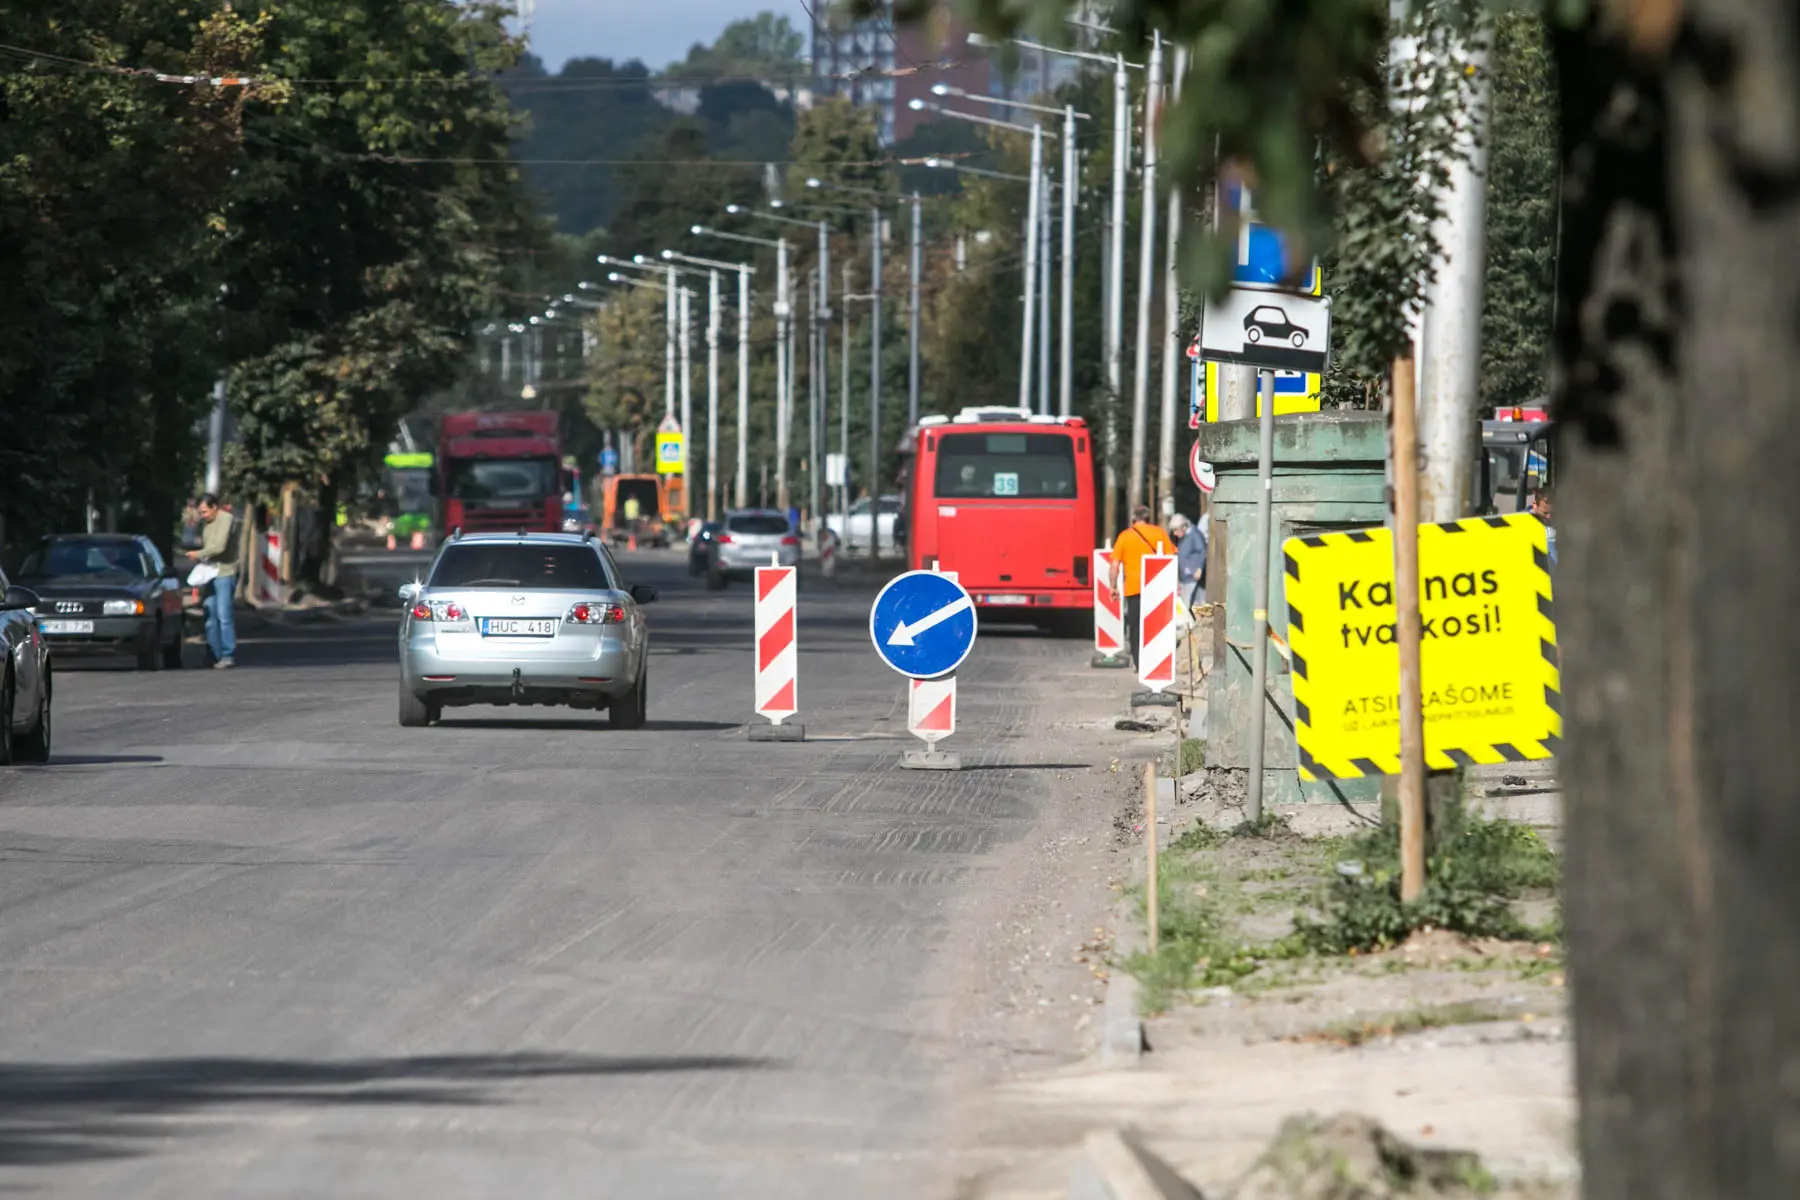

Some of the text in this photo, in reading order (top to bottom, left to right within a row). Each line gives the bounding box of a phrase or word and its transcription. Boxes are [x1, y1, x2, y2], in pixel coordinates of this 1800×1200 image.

[995, 477, 1016, 492] 39
[1338, 569, 1498, 611] Kanas
[490, 621, 518, 633] HUC
[528, 621, 551, 633] 418
[1340, 604, 1501, 648] tvakosi!
[1343, 682, 1513, 716] ATSIAŠOME
